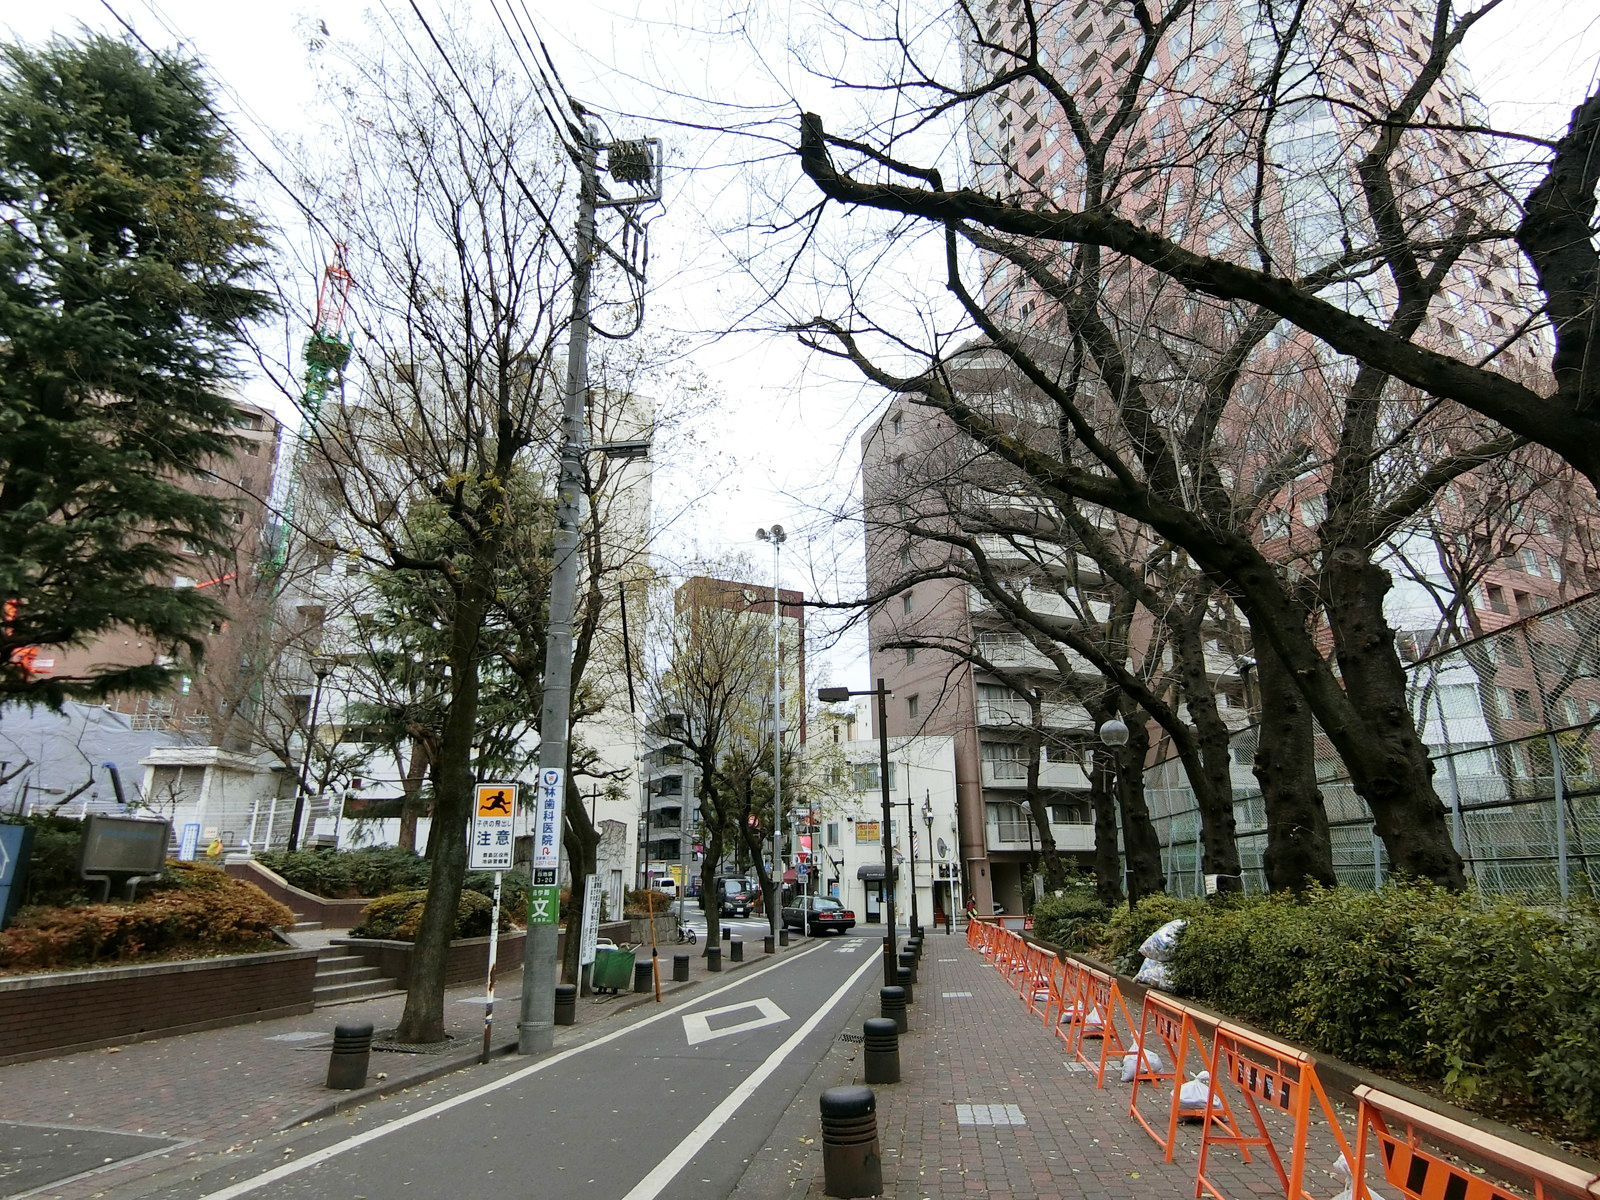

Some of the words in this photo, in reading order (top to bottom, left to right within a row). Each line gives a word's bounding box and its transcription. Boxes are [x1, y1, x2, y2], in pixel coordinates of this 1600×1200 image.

[542, 787, 556, 846] 林歯科医院
[476, 830, 511, 846] 注意
[531, 898, 549, 918] 文
